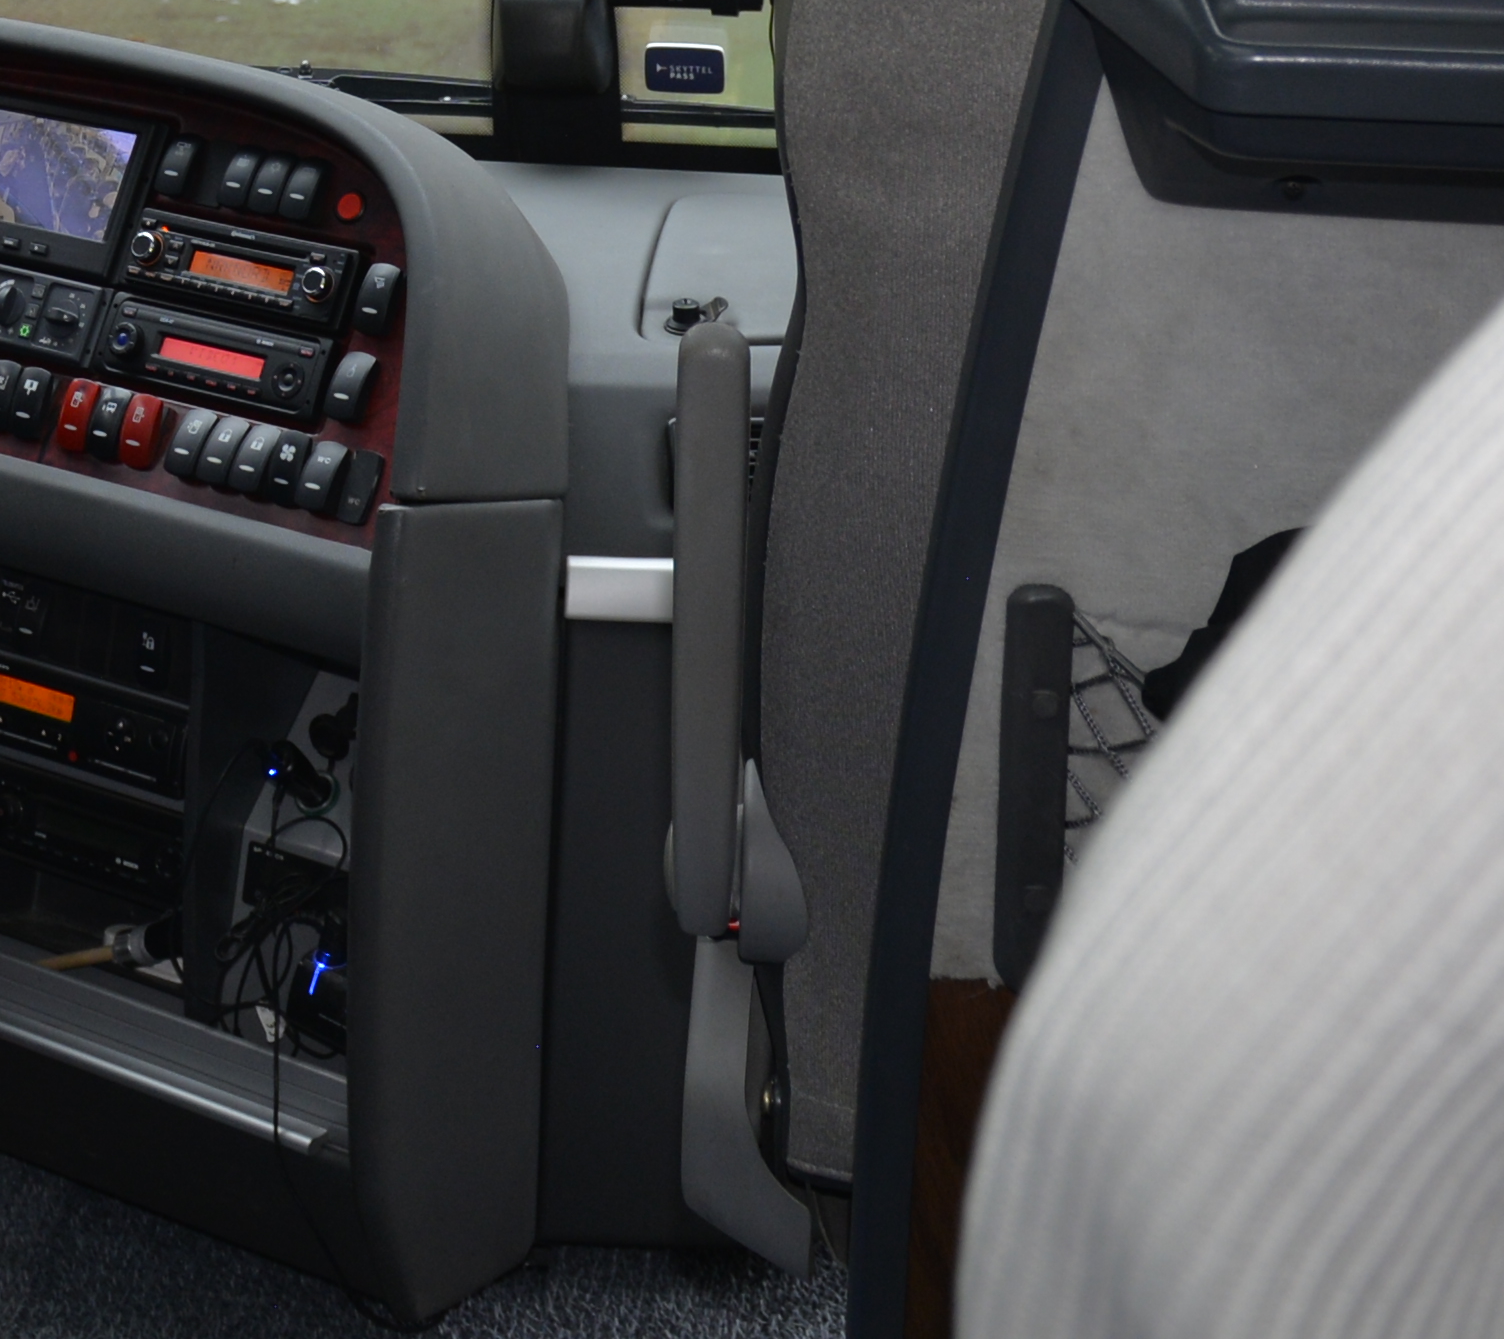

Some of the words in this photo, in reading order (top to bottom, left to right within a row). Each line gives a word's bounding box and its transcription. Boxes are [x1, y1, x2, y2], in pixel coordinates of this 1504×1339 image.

[669, 64, 713, 74] SKYTTEL
[669, 72, 695, 81] PASS
[317, 455, 331, 464] WC
